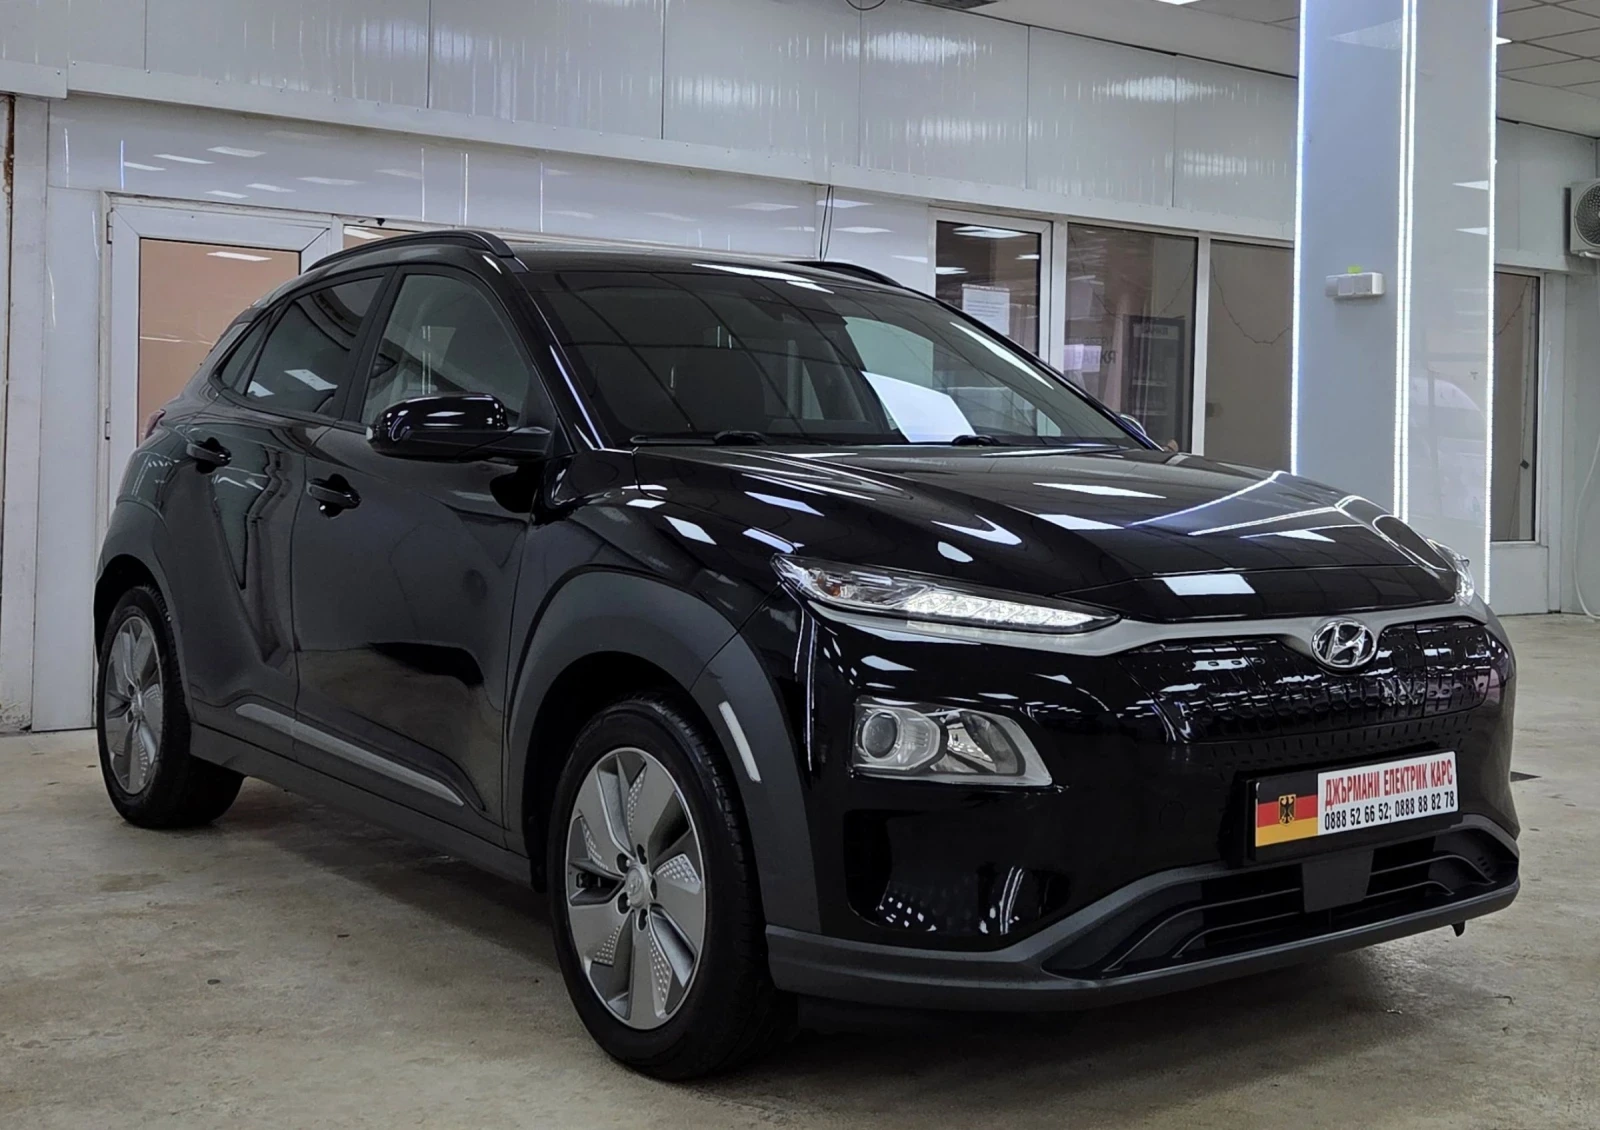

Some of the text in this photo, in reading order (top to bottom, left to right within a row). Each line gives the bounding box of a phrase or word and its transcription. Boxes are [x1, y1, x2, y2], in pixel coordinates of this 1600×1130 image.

[1325, 759, 1453, 811] ДЖЪРМАНИ ЕЛЕКТРИК КАРС
[1325, 791, 1455, 830] 0888 52 66 52; 0888 88 82 78
